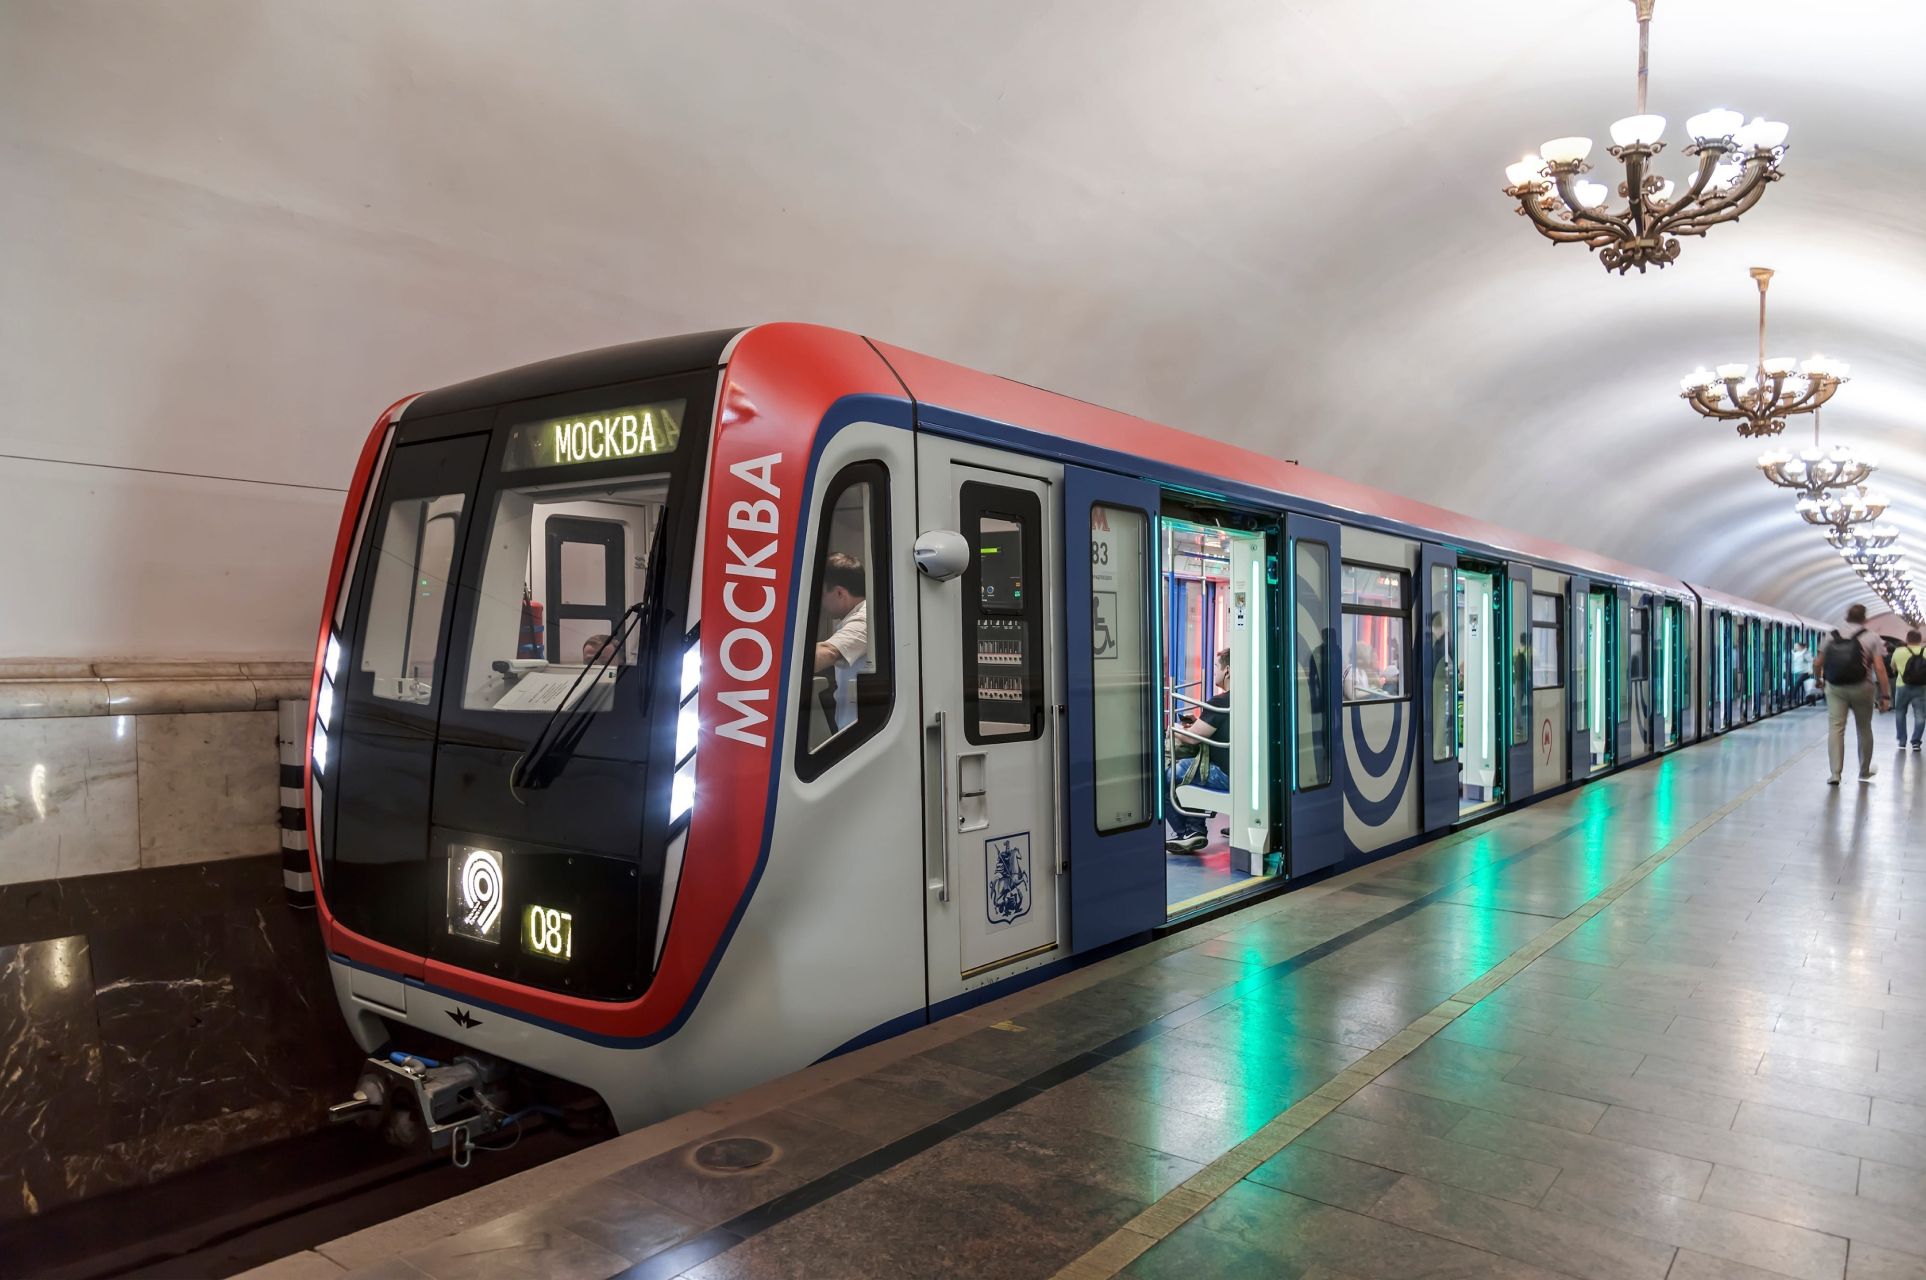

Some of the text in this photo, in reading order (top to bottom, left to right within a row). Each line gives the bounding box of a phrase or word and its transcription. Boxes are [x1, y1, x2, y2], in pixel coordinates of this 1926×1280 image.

[555, 412, 657, 463] МОСКВА
[715, 452, 782, 748] МОСКВА
[531, 905, 572, 957] 087
